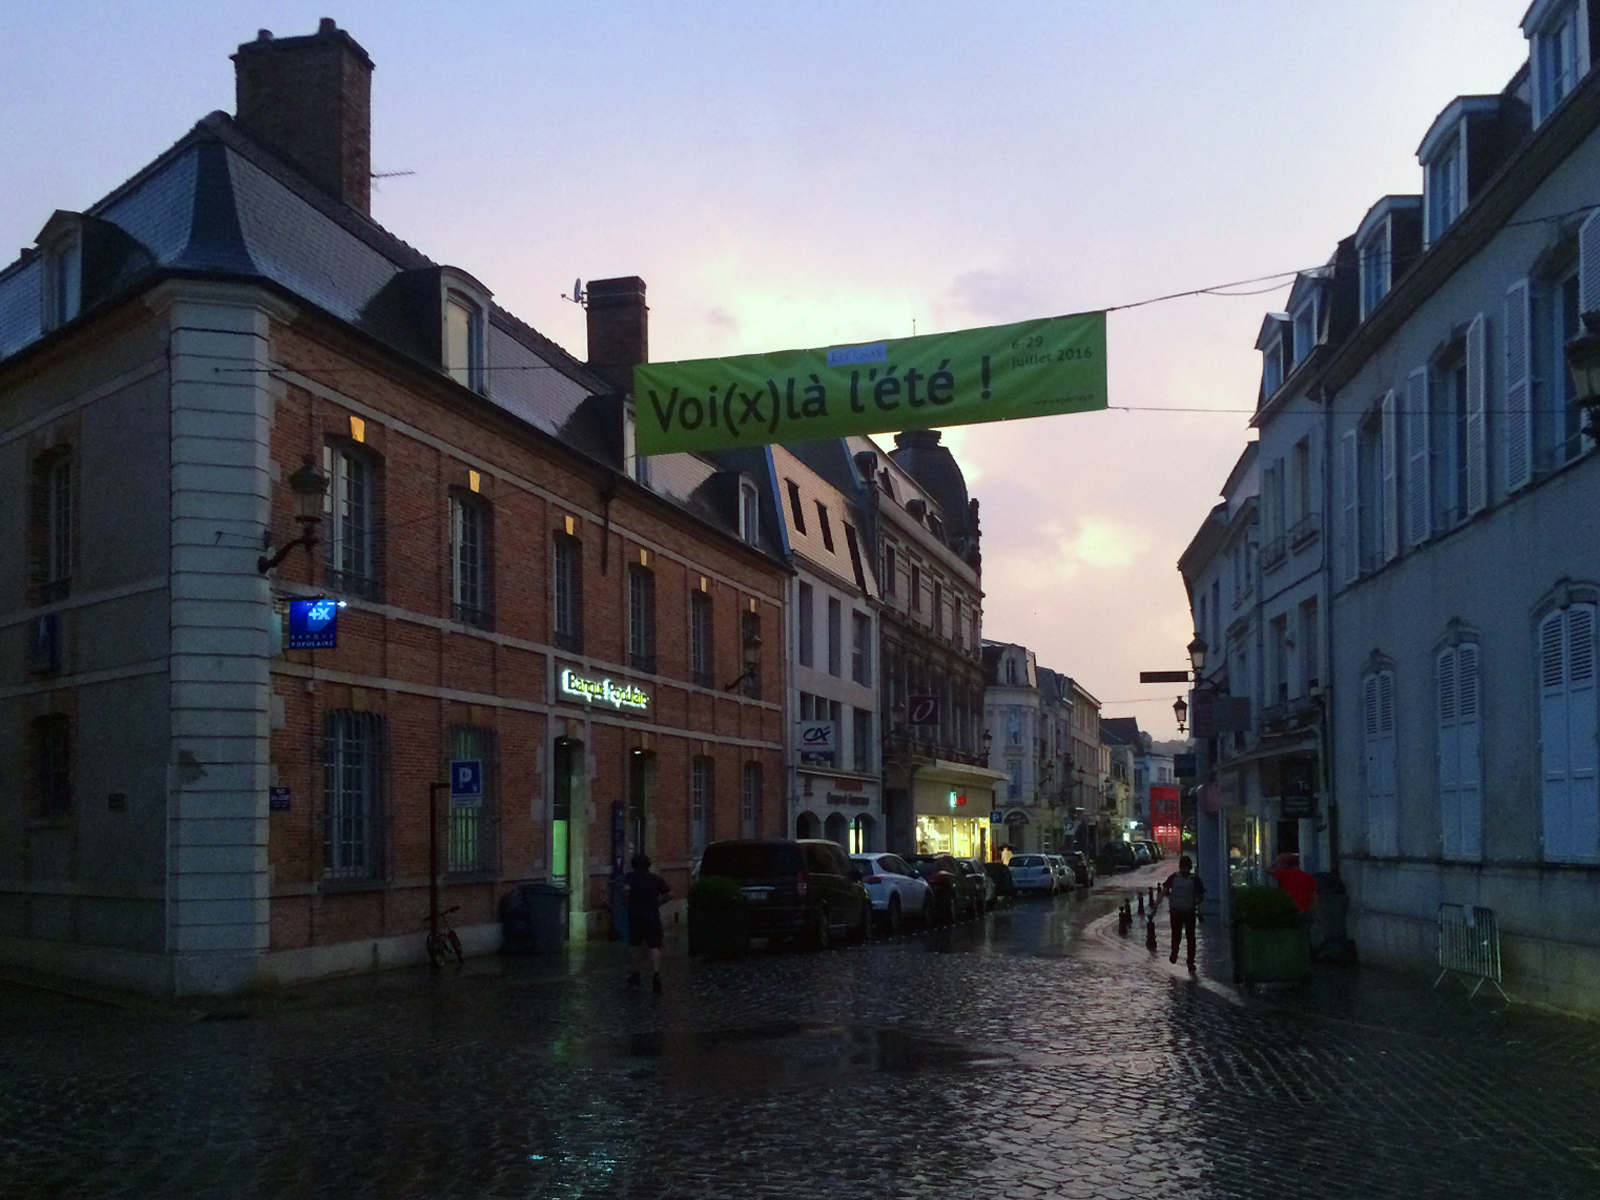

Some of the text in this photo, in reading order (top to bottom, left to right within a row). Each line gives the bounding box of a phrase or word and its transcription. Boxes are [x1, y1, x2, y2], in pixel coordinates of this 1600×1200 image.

[1011, 335, 1043, 350] 6-29
[1011, 347, 1093, 371] juillet 2016
[648, 355, 992, 437] Voi(x)là l'été !
[291, 640, 334, 648] POPULAIRE
[459, 767, 473, 789] P
[992, 812, 1000, 822] P
